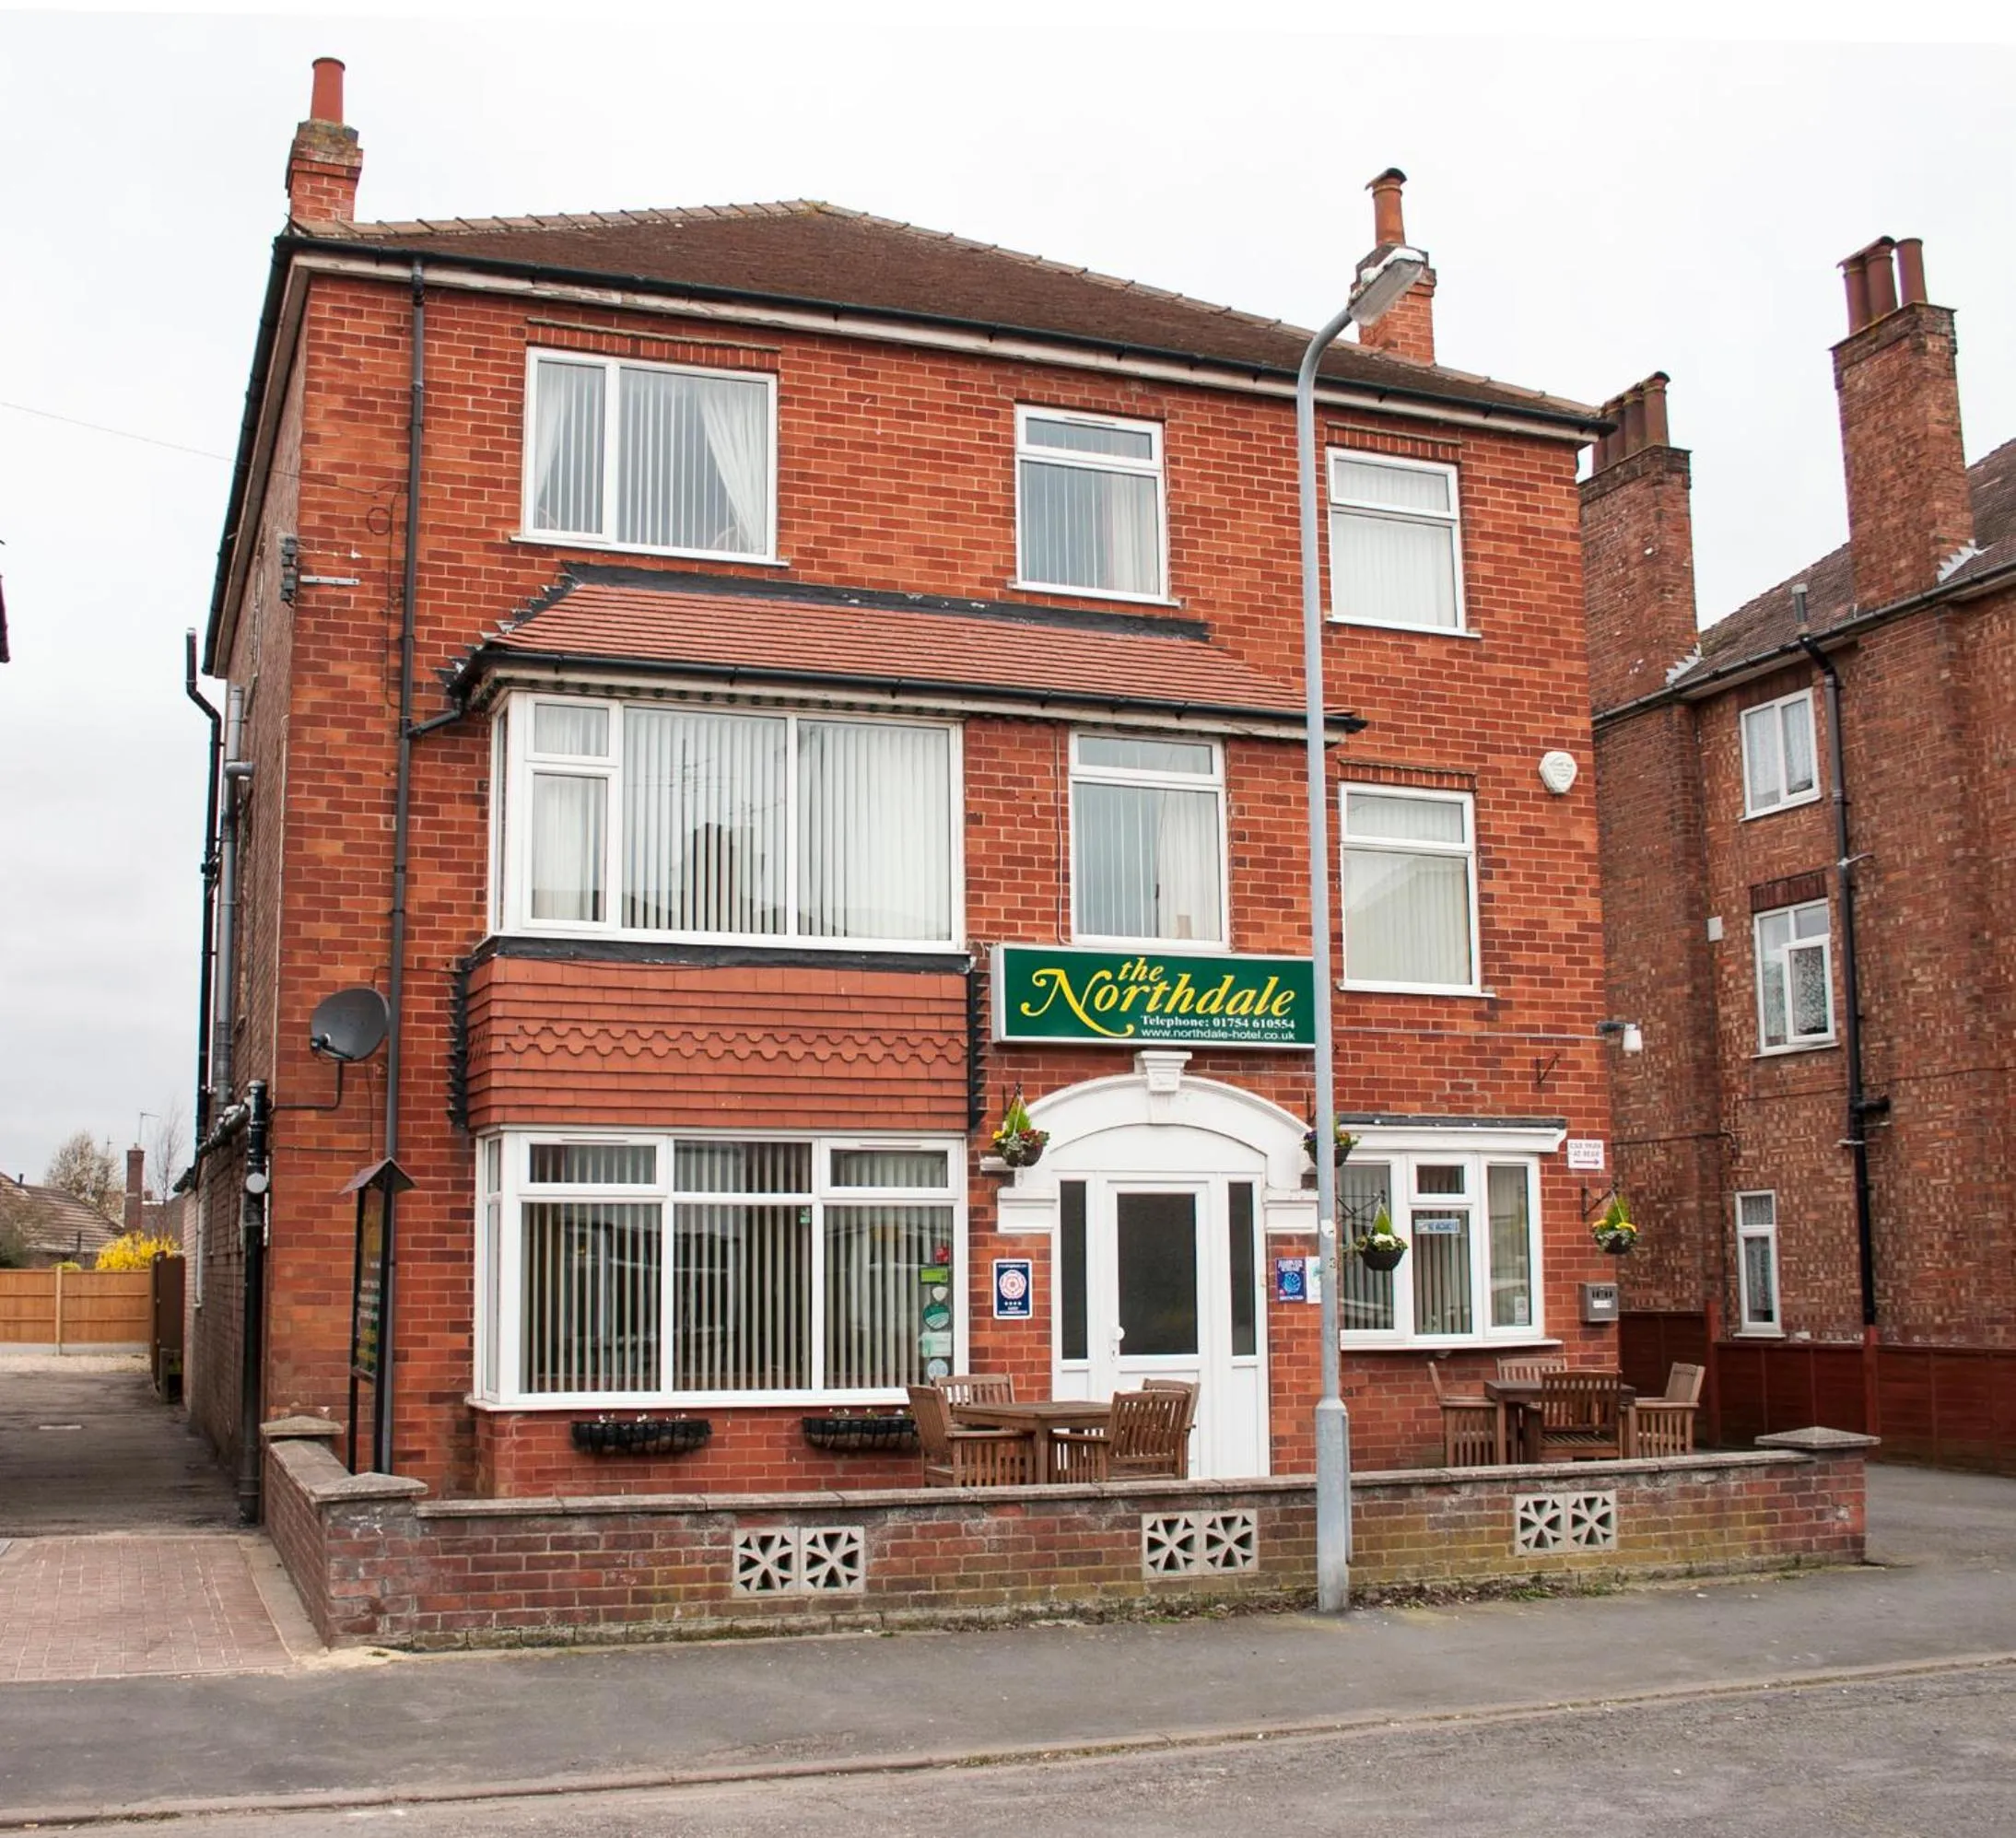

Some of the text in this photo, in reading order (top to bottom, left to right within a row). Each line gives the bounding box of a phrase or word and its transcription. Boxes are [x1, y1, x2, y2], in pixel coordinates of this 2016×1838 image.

[1118, 957, 1165, 981] the
[1020, 968, 1295, 1037] Northdale
[1141, 1015, 1295, 1029] Telephone: 01754 610554
[1141, 1027, 1295, 1040] www.northdale-hotel.co.uk
